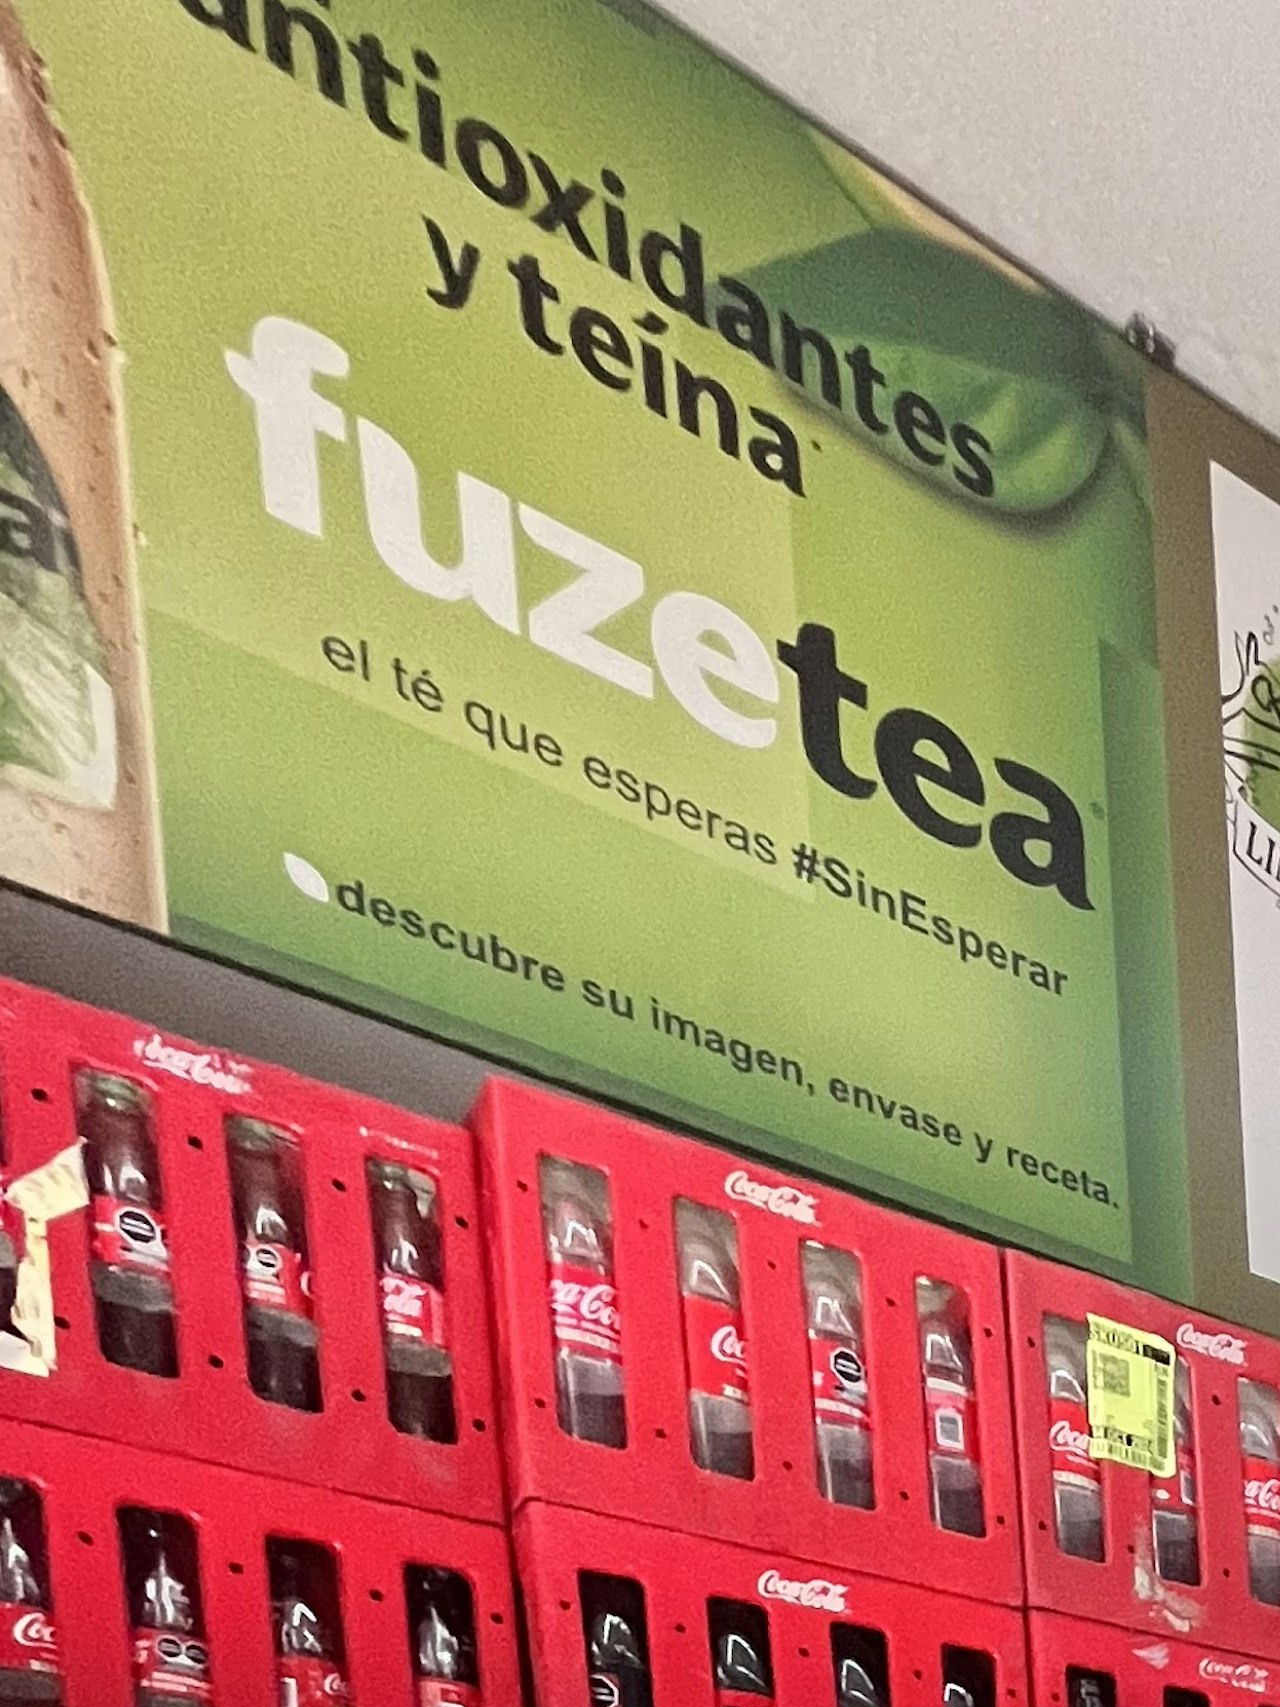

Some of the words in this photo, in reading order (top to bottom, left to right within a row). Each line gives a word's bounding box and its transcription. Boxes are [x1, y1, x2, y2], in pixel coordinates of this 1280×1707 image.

[420, 214, 481, 309] y
[321, 632, 371, 684] el
[392, 657, 446, 714] té
[463, 699, 566, 778] que
[583, 755, 779, 869] esperas
[791, 840, 1070, 1001] #SinEsperar
[336, 875, 566, 995] descubre
[580, 975, 636, 1025] su
[649, 994, 817, 1099] imagen,
[827, 1071, 964, 1151] envase
[974, 1120, 996, 1167] y
[1004, 1139, 1122, 1210] receta.
